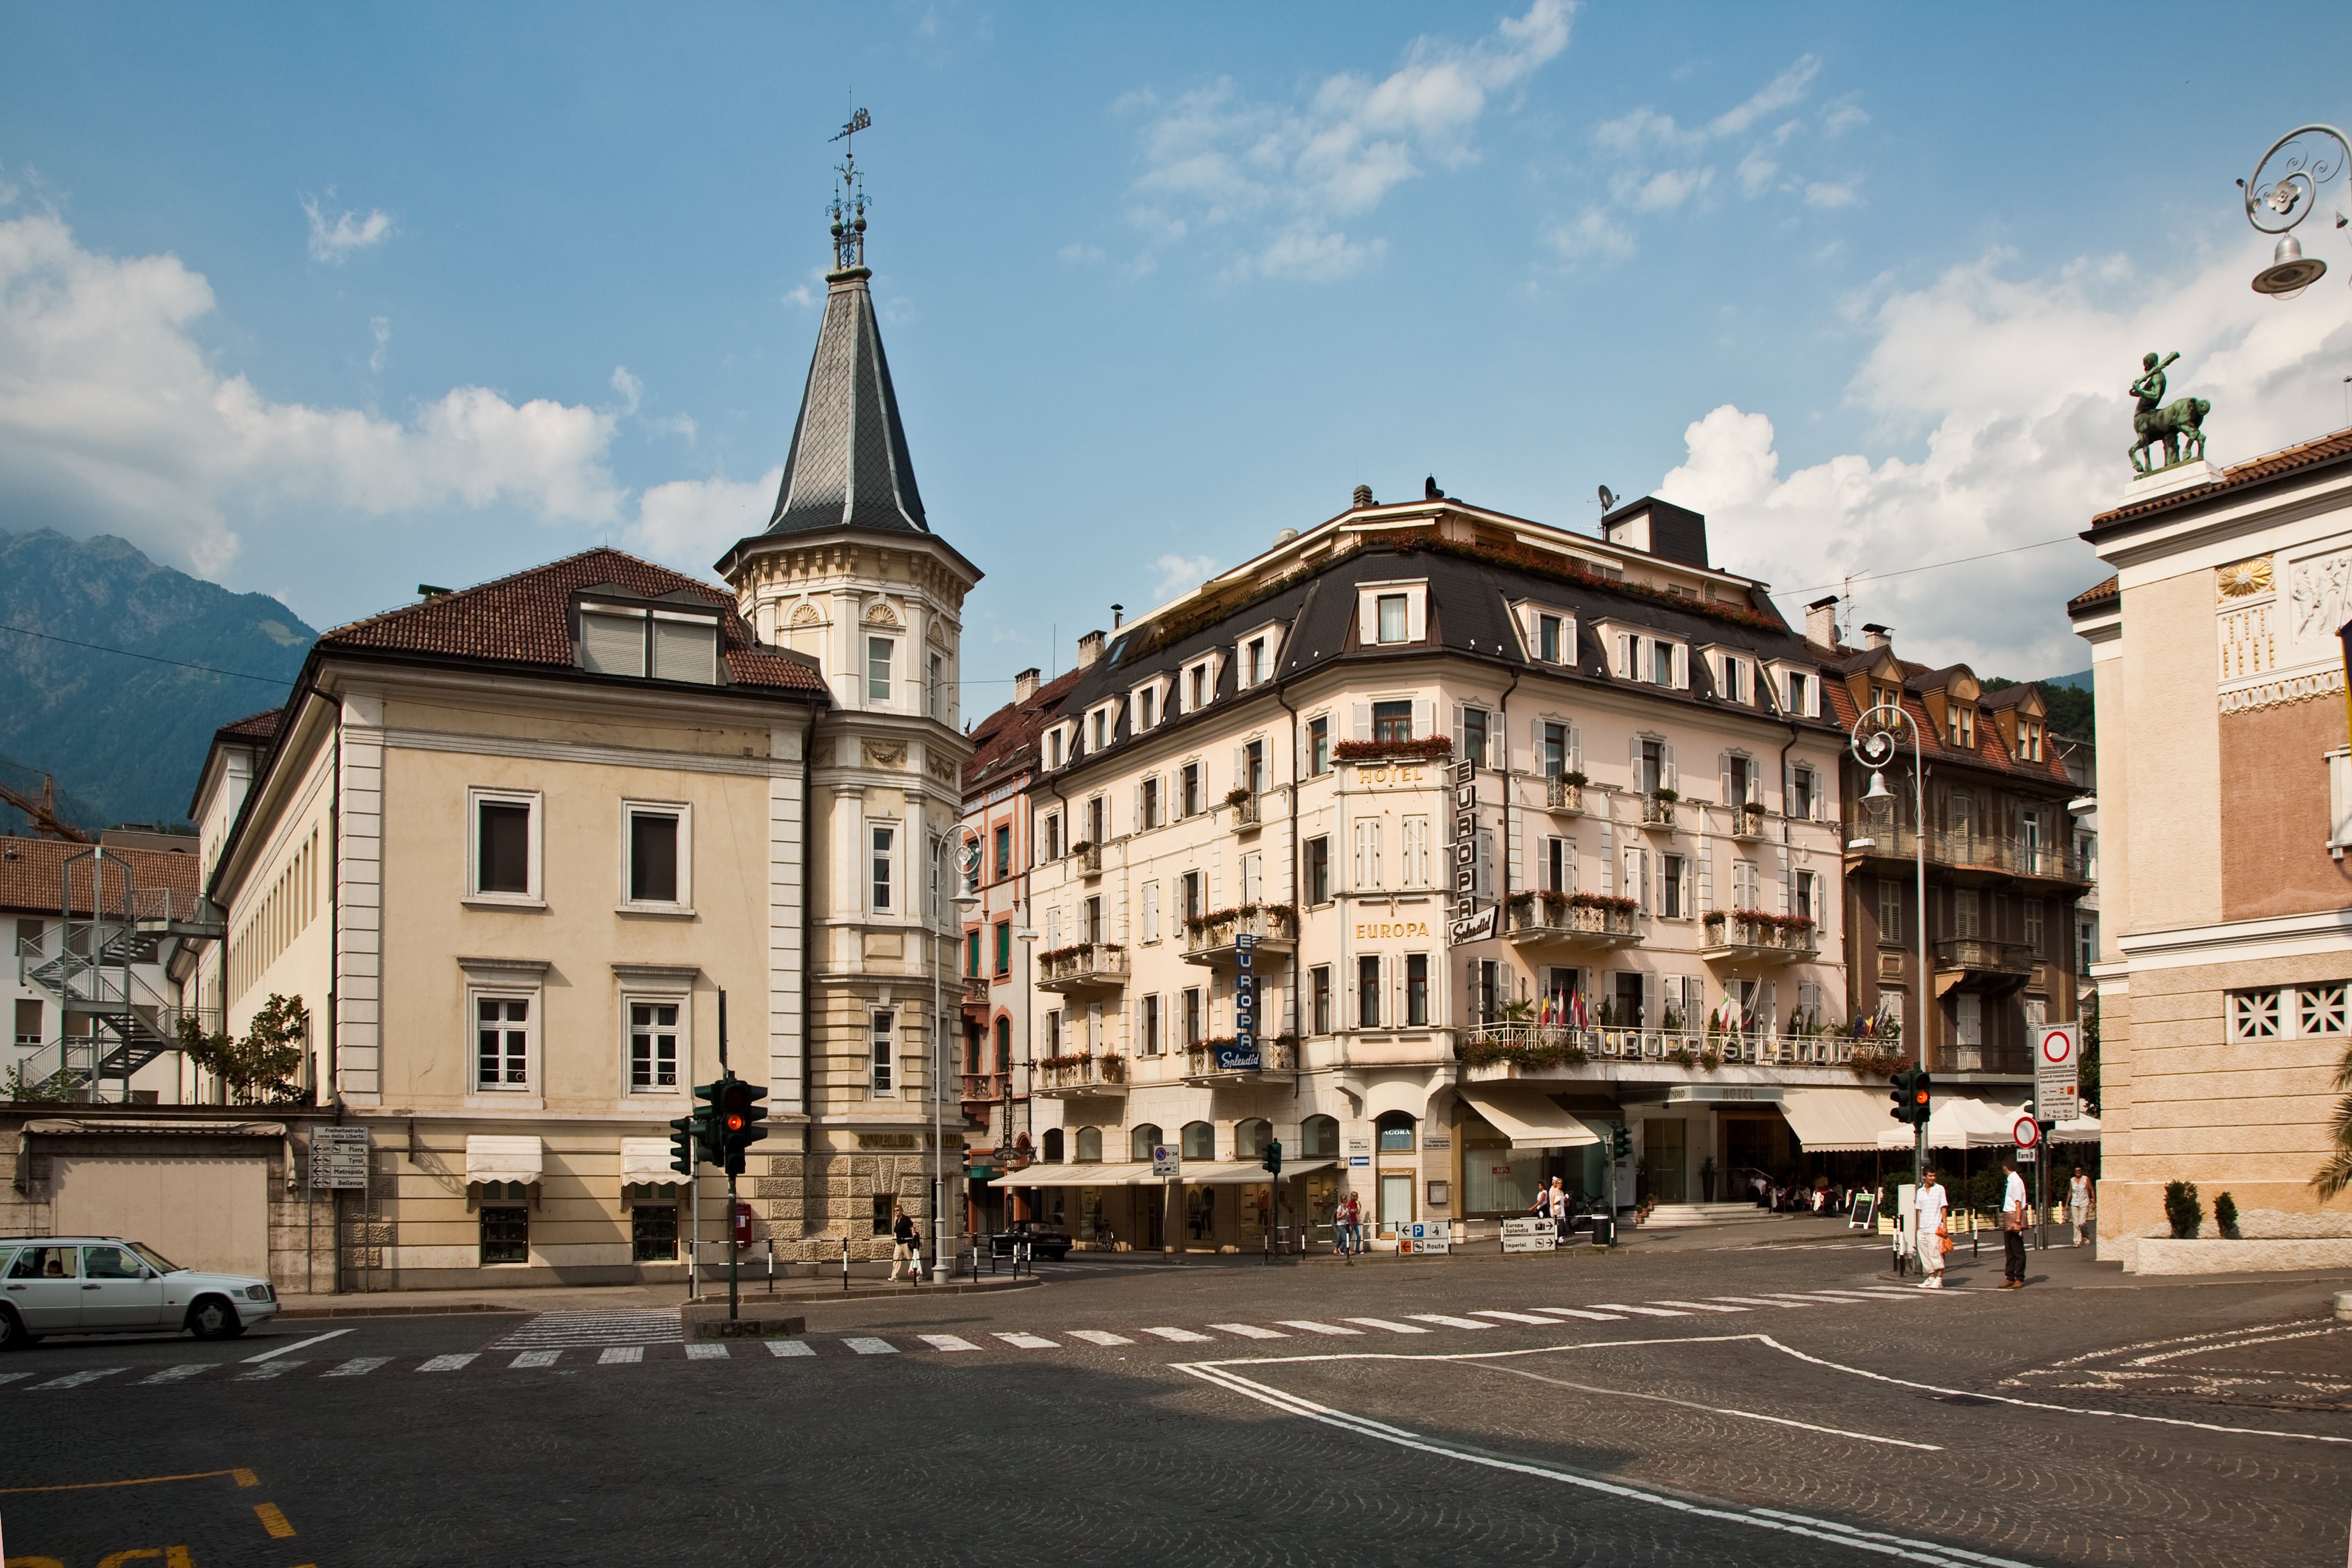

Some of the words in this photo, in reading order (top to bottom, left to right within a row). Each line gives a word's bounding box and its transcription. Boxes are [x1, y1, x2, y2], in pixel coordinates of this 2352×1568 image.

[1360, 766, 1423, 783] HOTEL
[1457, 762, 1471, 919] EUROPA
[1356, 922, 1430, 939] EUROPA
[1453, 914, 1490, 944] Splendid
[1240, 936, 1252, 1047] EUROPA
[1579, 1032, 1701, 1056] EUROPA
[1723, 1039, 1853, 1062] SPLENDID
[1221, 1052, 1260, 1068] Splendid
[1723, 1088, 1755, 1100] HOTEL
